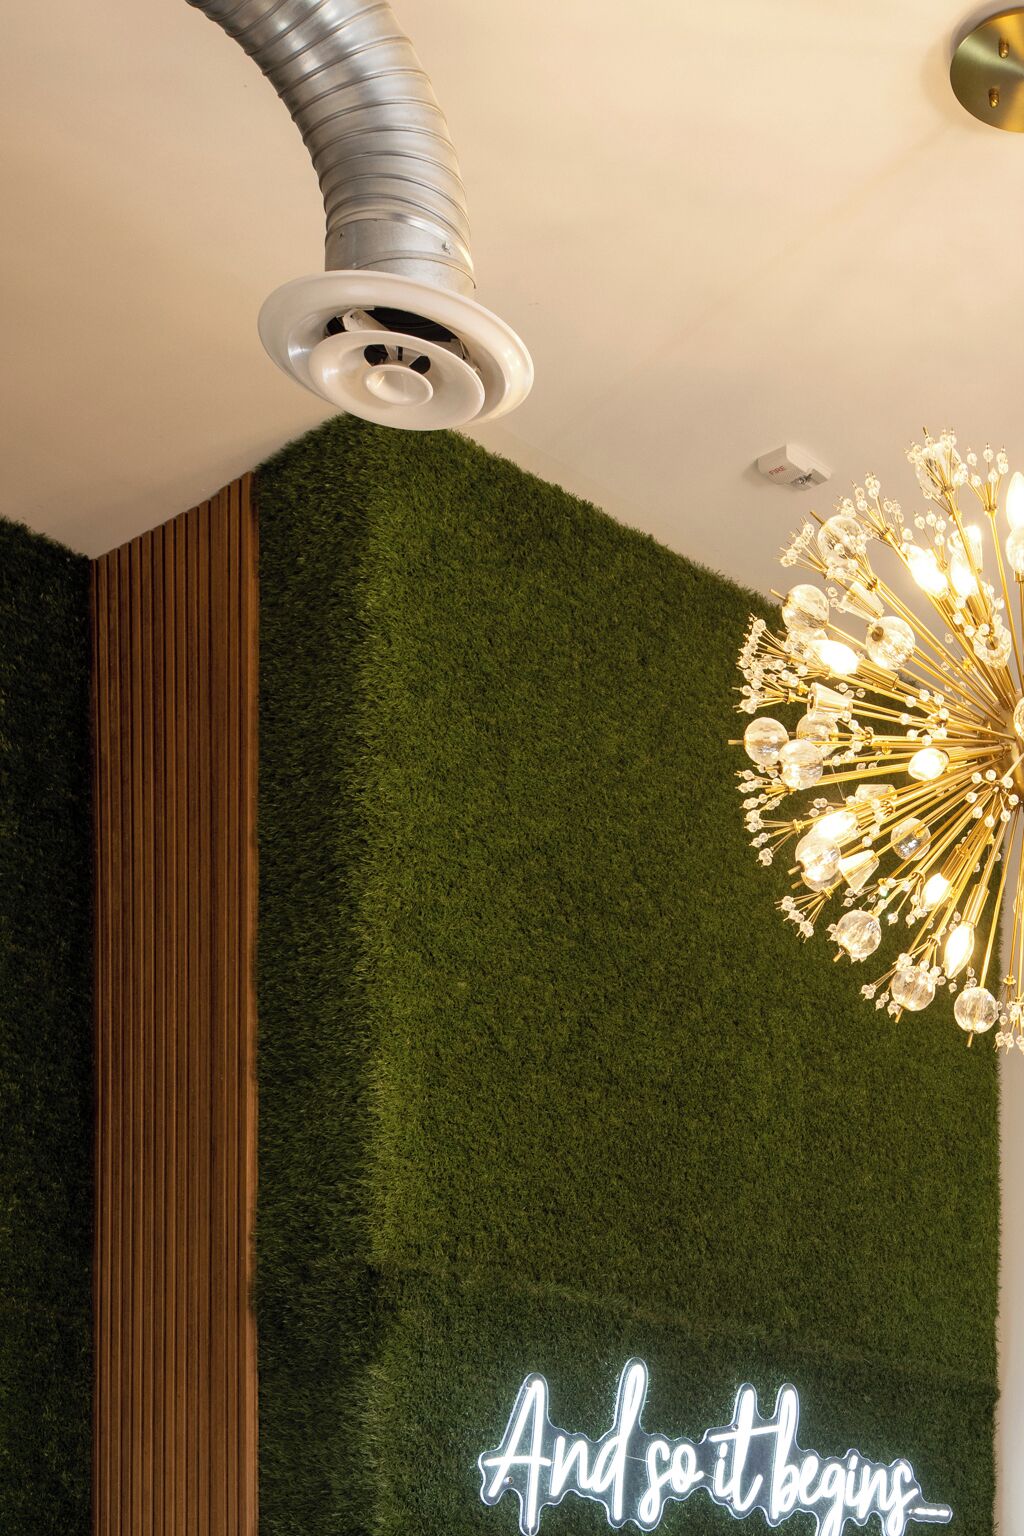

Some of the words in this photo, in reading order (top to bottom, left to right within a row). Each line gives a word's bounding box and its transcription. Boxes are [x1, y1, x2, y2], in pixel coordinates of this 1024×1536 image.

[768, 465, 785, 476] FIRE
[484, 1364, 645, 1531] And
[638, 1439, 704, 1525] so
[709, 1388, 778, 1508] it
